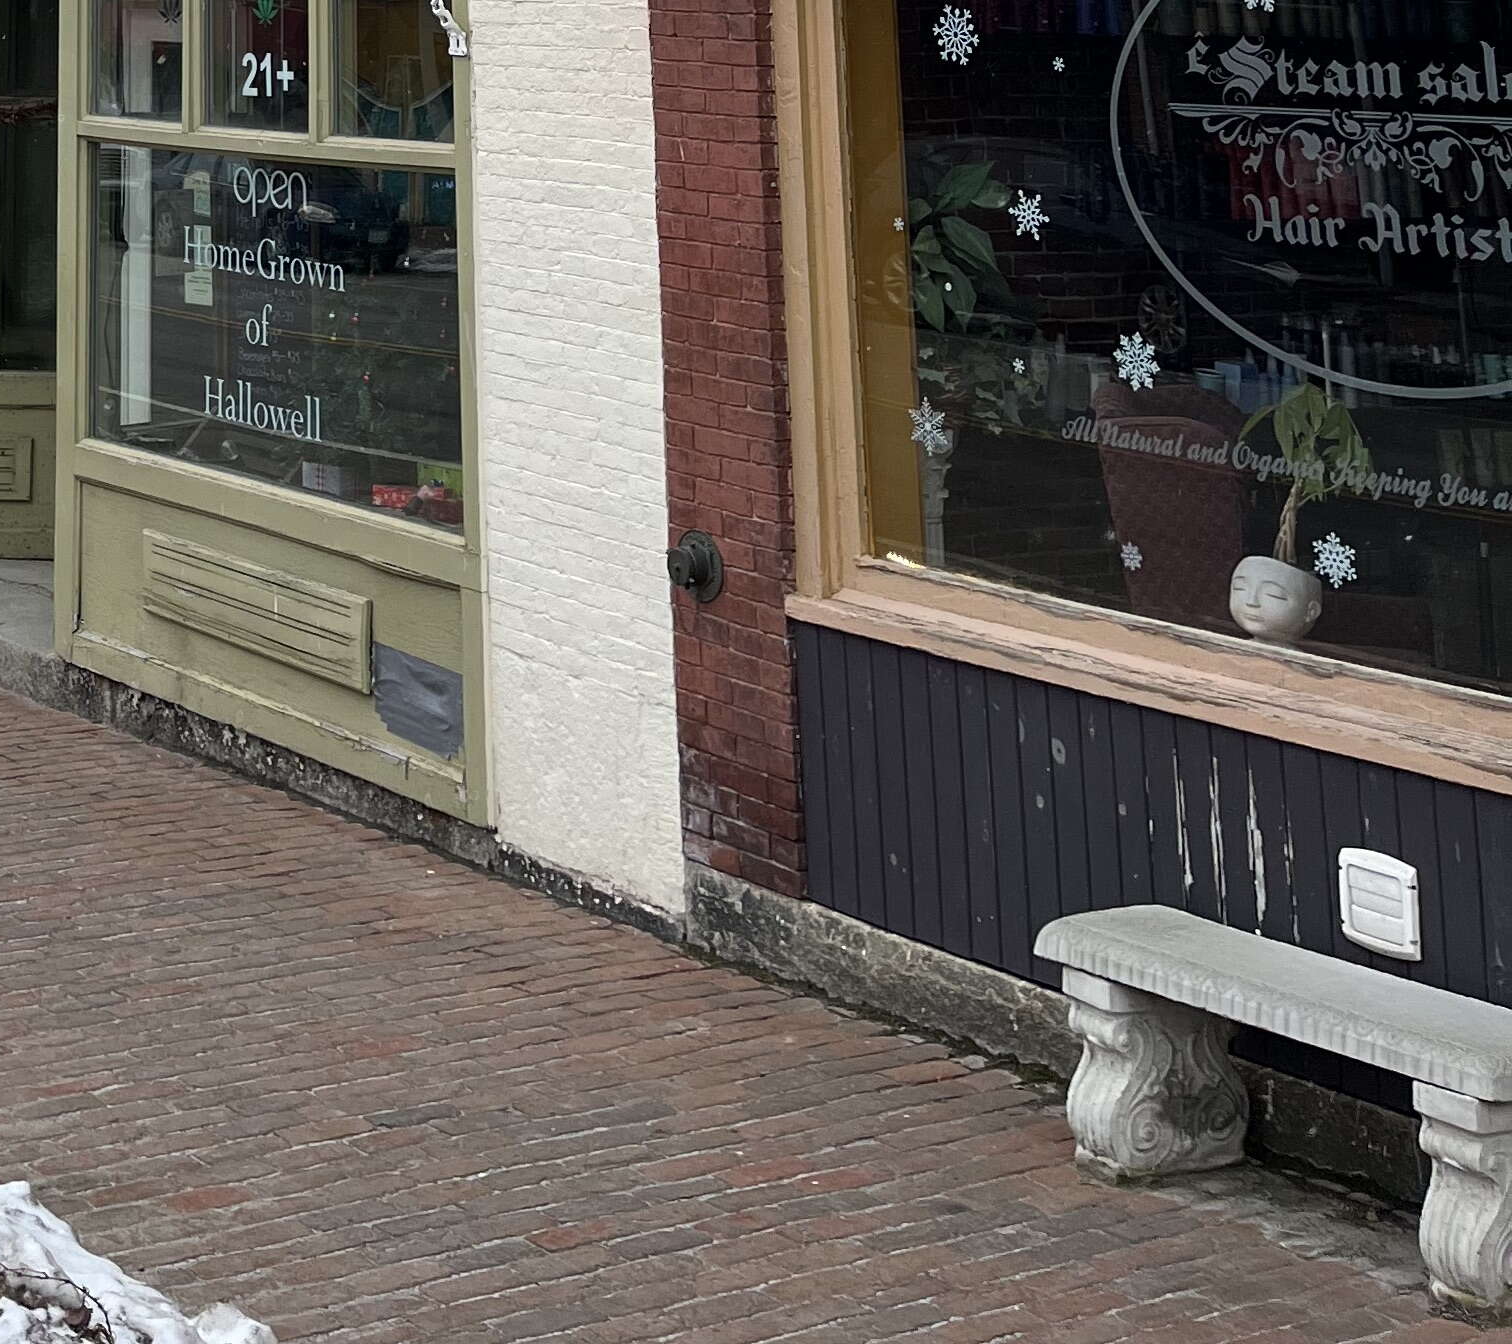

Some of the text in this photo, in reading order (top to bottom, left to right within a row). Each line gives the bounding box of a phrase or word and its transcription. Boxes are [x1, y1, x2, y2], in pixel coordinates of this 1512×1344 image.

[241, 52, 295, 97] 21+
[233, 166, 308, 218] open
[1243, 193, 1346, 247] Hair
[184, 225, 346, 293] HomeGrown
[245, 304, 272, 347] of
[203, 375, 322, 442] Hallowell
[1061, 415, 1097, 444] All
[1100, 422, 1184, 457] Natural
[1188, 440, 1229, 465] and
[1232, 440, 1325, 482] Organic
[1330, 458, 1433, 508] Keeping
[1438, 473, 1489, 507] You
